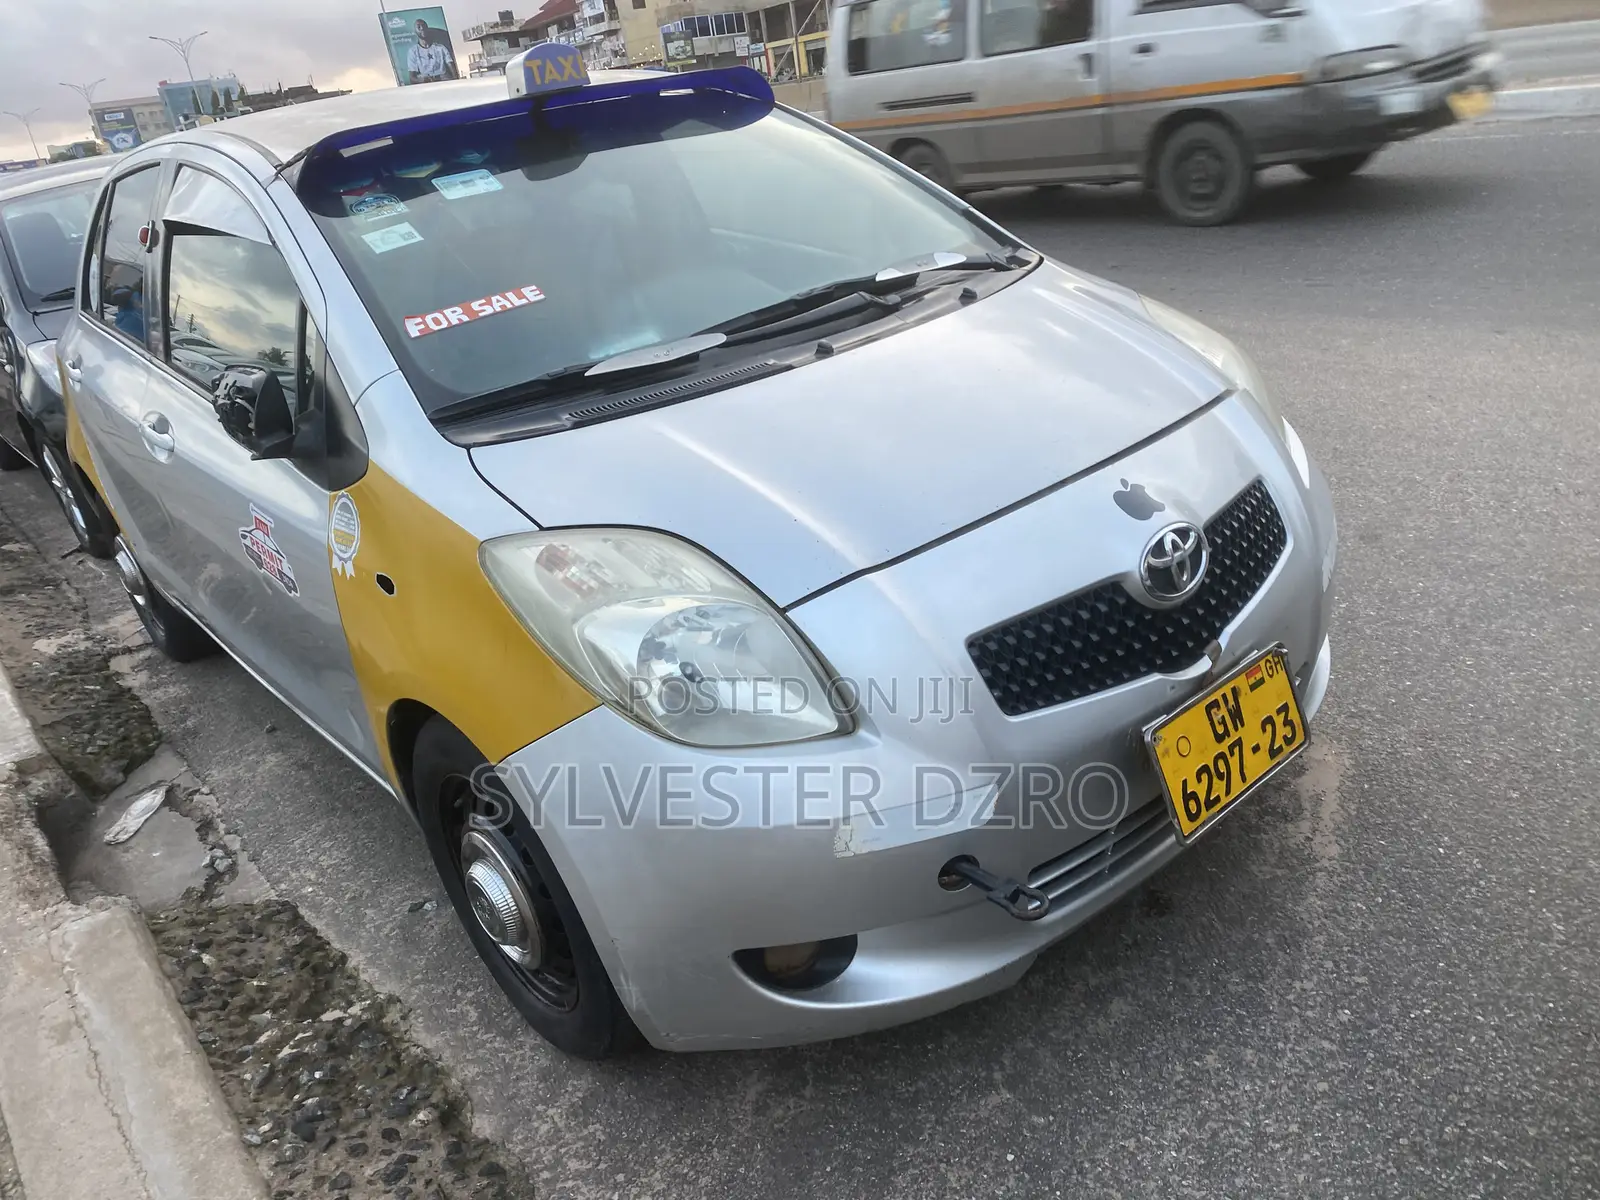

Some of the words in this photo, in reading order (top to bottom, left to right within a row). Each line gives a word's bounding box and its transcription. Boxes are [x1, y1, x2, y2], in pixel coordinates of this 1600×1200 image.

[526, 55, 588, 86] TAXI
[405, 306, 470, 338] FOR
[471, 285, 545, 317] SALE
[1265, 655, 1283, 679] GH
[1205, 685, 1245, 744] GW
[1181, 701, 1297, 823] 6297-23
